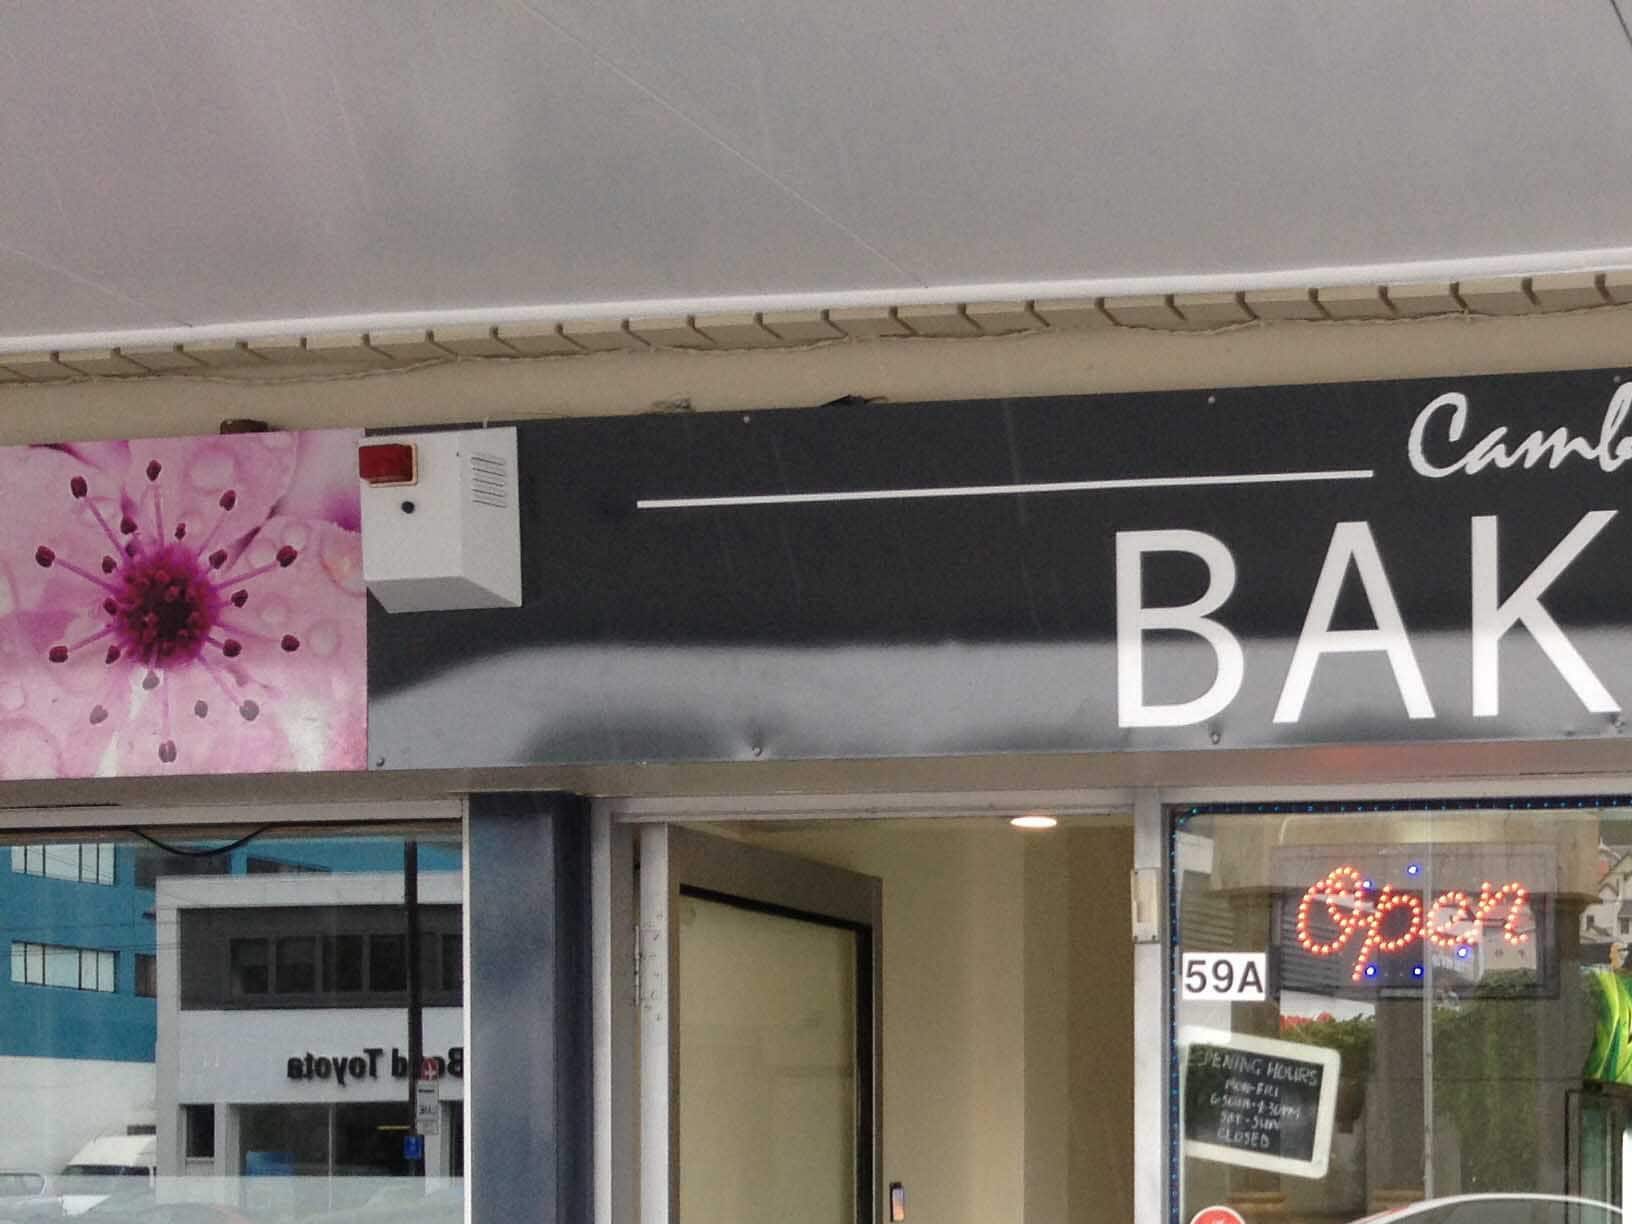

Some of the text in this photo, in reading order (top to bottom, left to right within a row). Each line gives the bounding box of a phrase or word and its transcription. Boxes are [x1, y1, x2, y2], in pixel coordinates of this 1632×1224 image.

[1295, 863, 1531, 983] Open
[1184, 959, 1266, 995] 59A
[1267, 1062, 1317, 1087] HOURS
[1217, 1128, 1270, 1149] CLOSED
